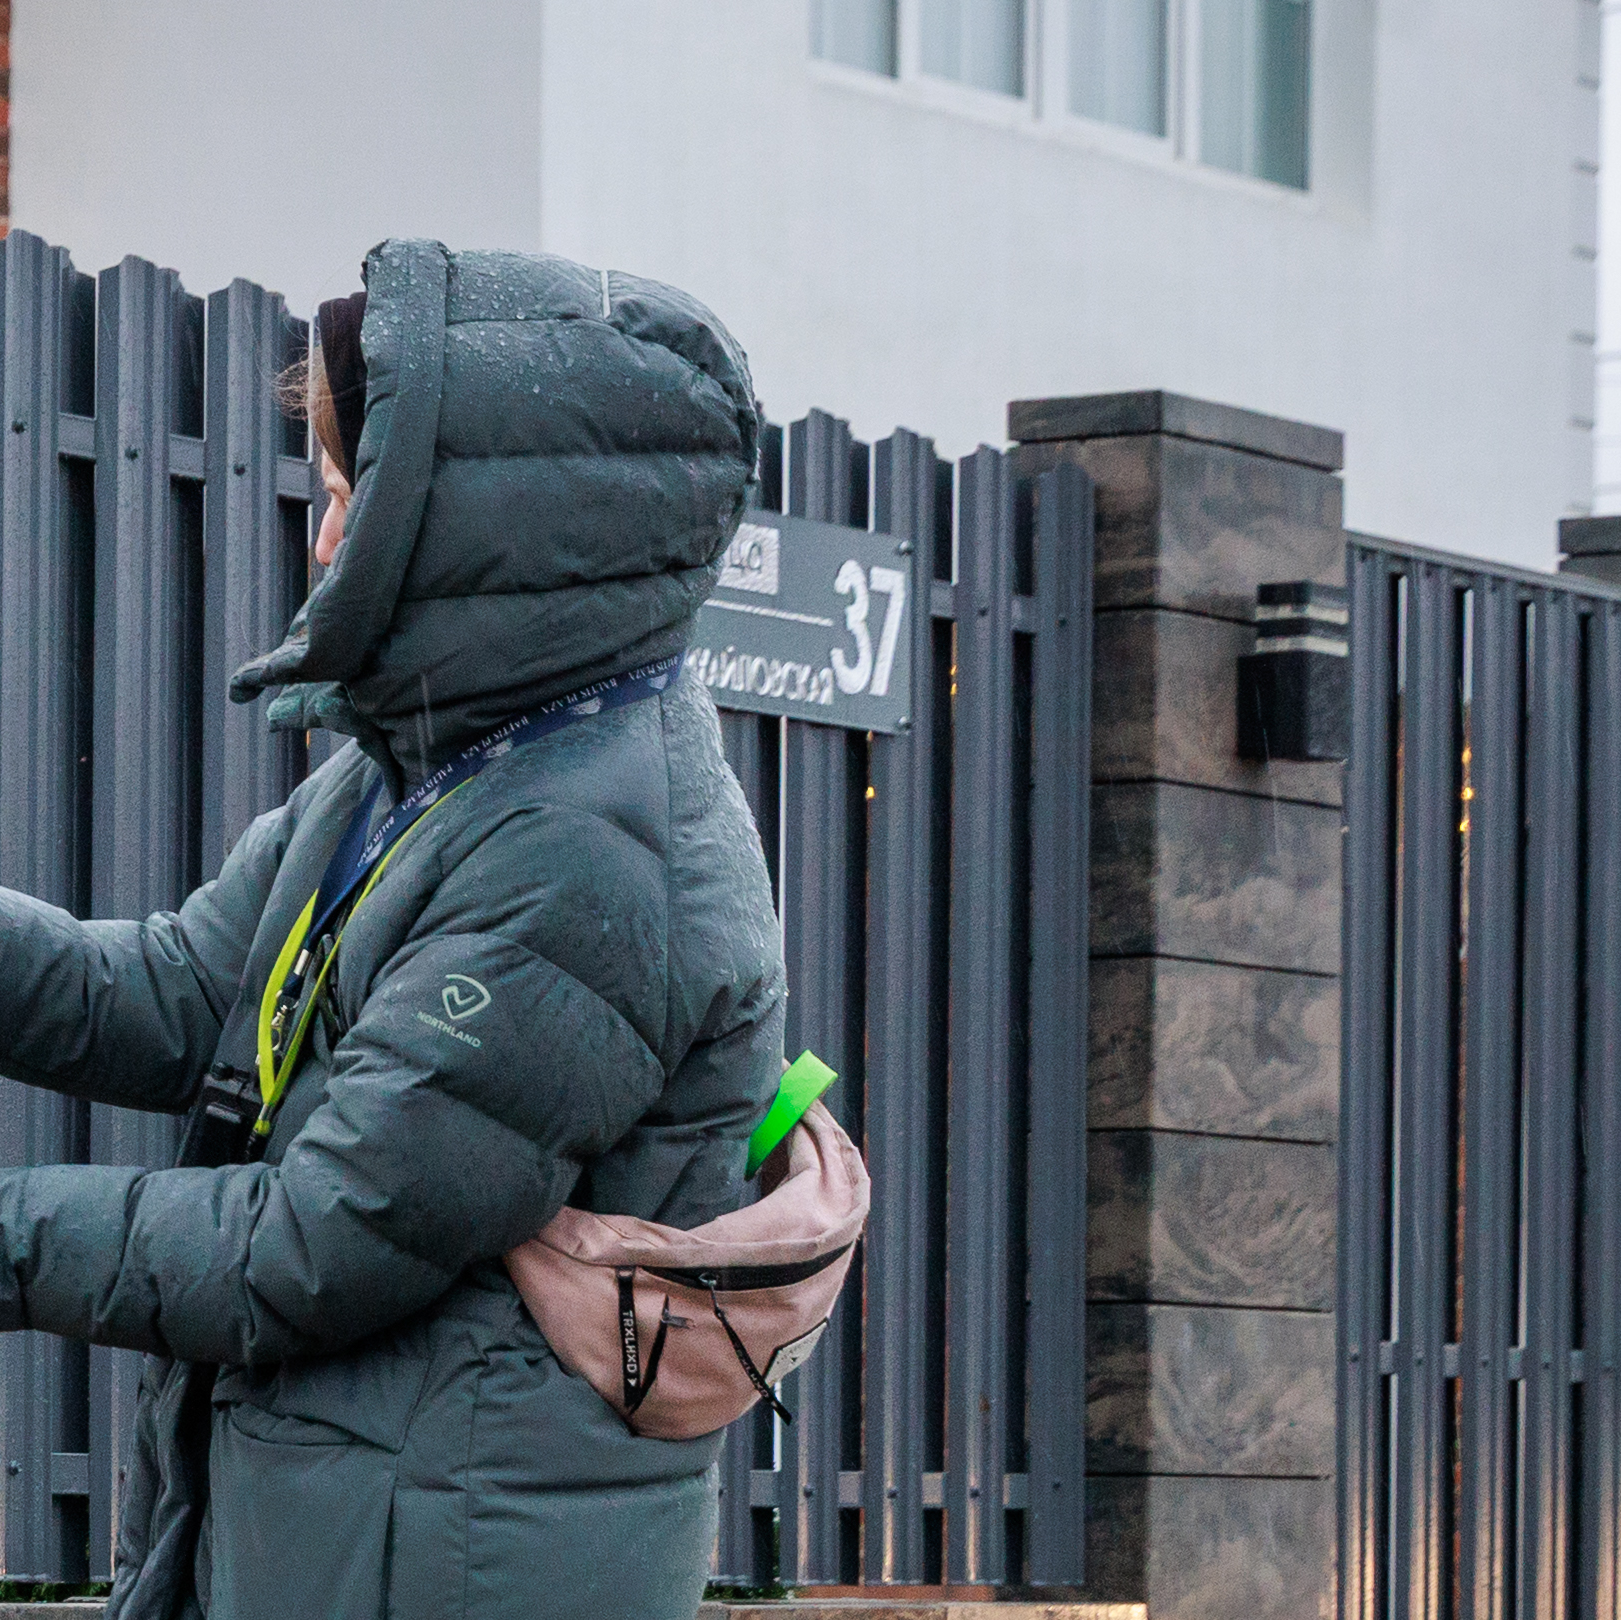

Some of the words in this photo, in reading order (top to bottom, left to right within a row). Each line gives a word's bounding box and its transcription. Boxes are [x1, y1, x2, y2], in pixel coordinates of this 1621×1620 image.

[831, 559, 906, 695] 37
[416, 1011, 482, 1048] NORTHLAND
[622, 1309, 638, 1374] TRXLHXD
